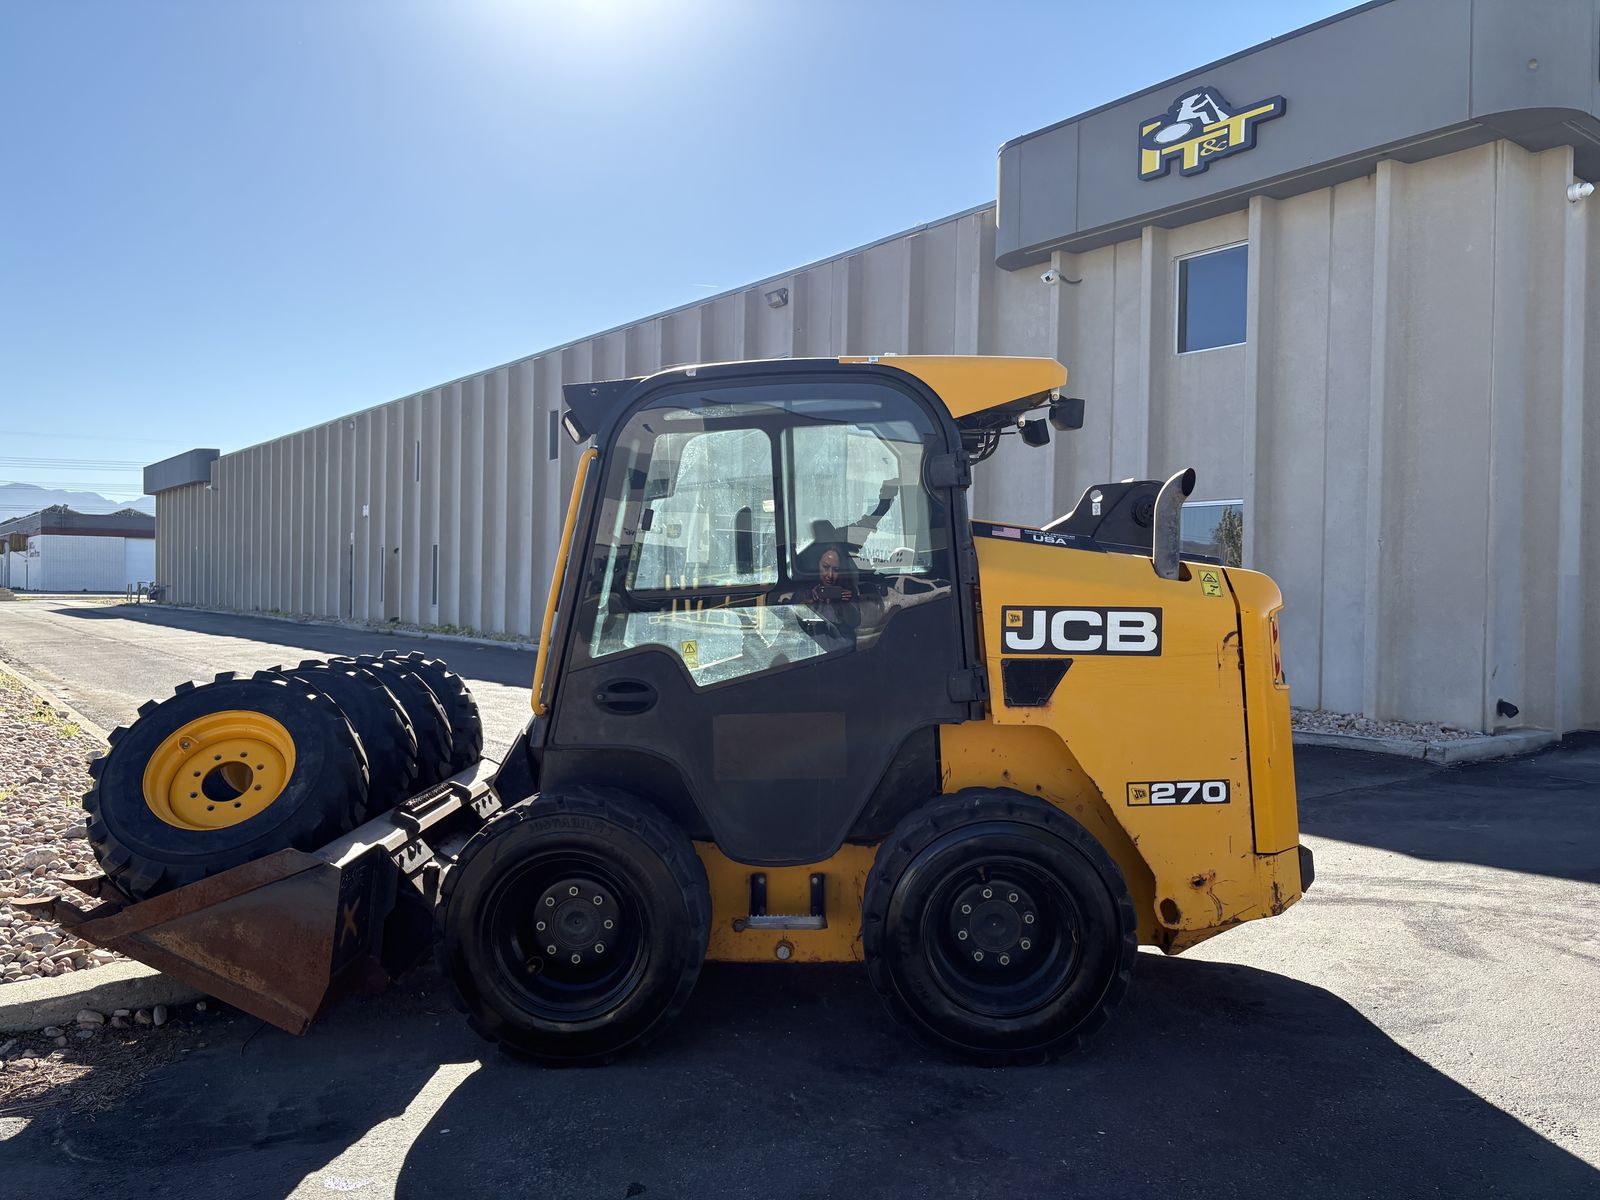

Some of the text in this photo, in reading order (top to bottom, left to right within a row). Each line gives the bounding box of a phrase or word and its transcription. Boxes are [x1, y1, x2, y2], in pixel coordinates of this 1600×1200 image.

[1033, 534, 1067, 545] USA
[1005, 610, 1159, 652] JCB
[1151, 781, 1226, 804] 270
